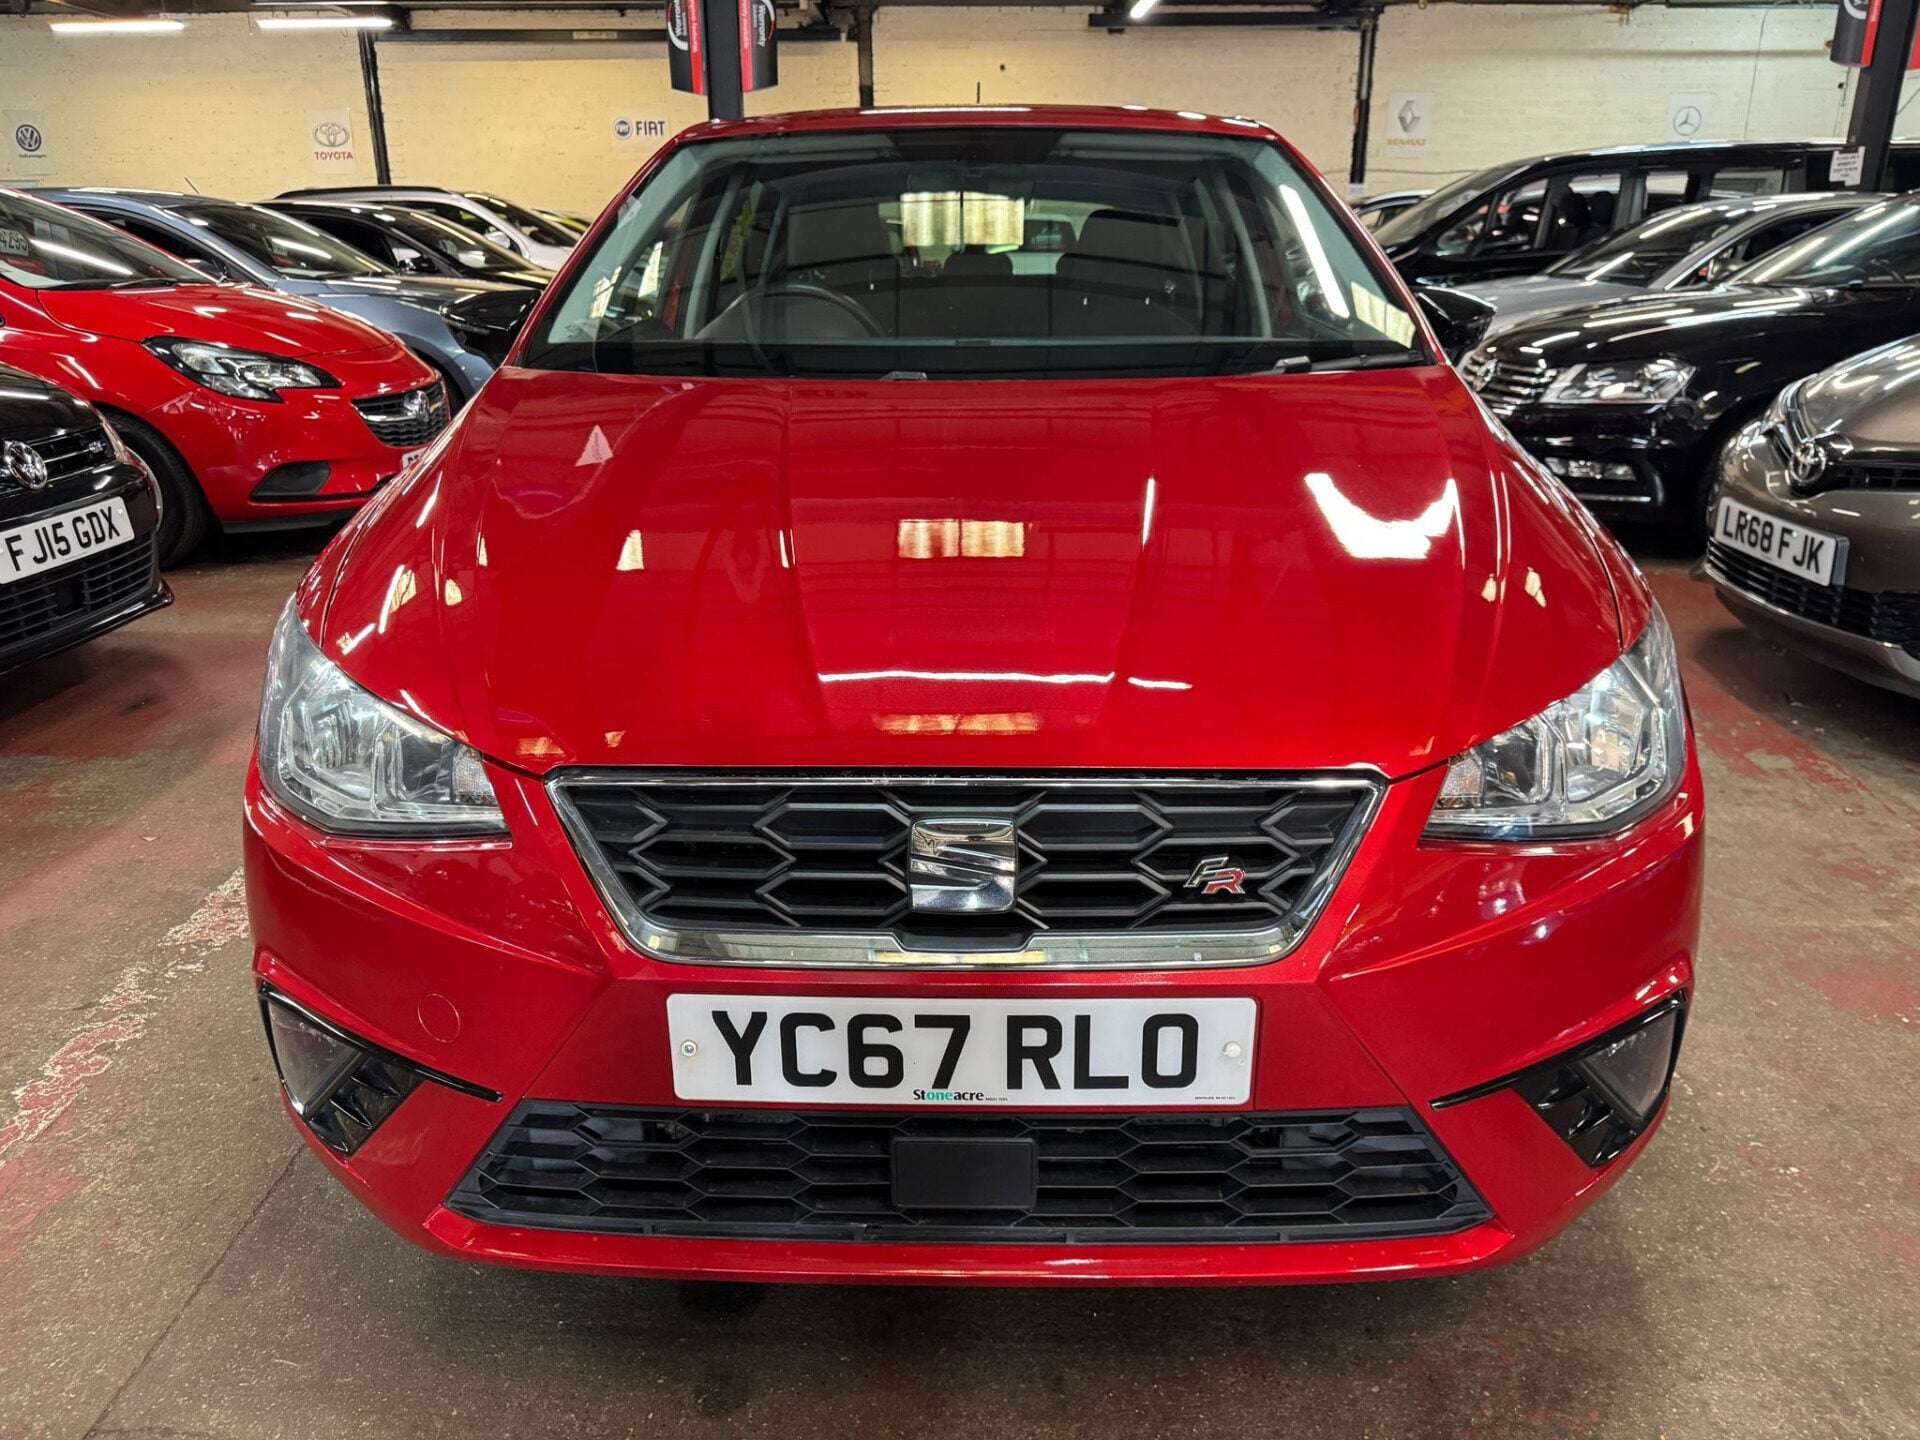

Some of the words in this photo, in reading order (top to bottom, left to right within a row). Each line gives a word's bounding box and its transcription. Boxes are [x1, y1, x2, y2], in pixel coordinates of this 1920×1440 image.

[758, 4, 766, 48] Warranty
[636, 120, 665, 136] FIAT
[313, 151, 354, 160] TOYOTA
[71, 506, 121, 549] GDX
[1723, 505, 1774, 553] LR68
[1777, 526, 1825, 574] FJK
[1183, 856, 1247, 894] FR
[711, 1010, 971, 1089] YC67
[1006, 1012, 1199, 1089] RLO
[913, 1088, 985, 1101] Stoneacre
